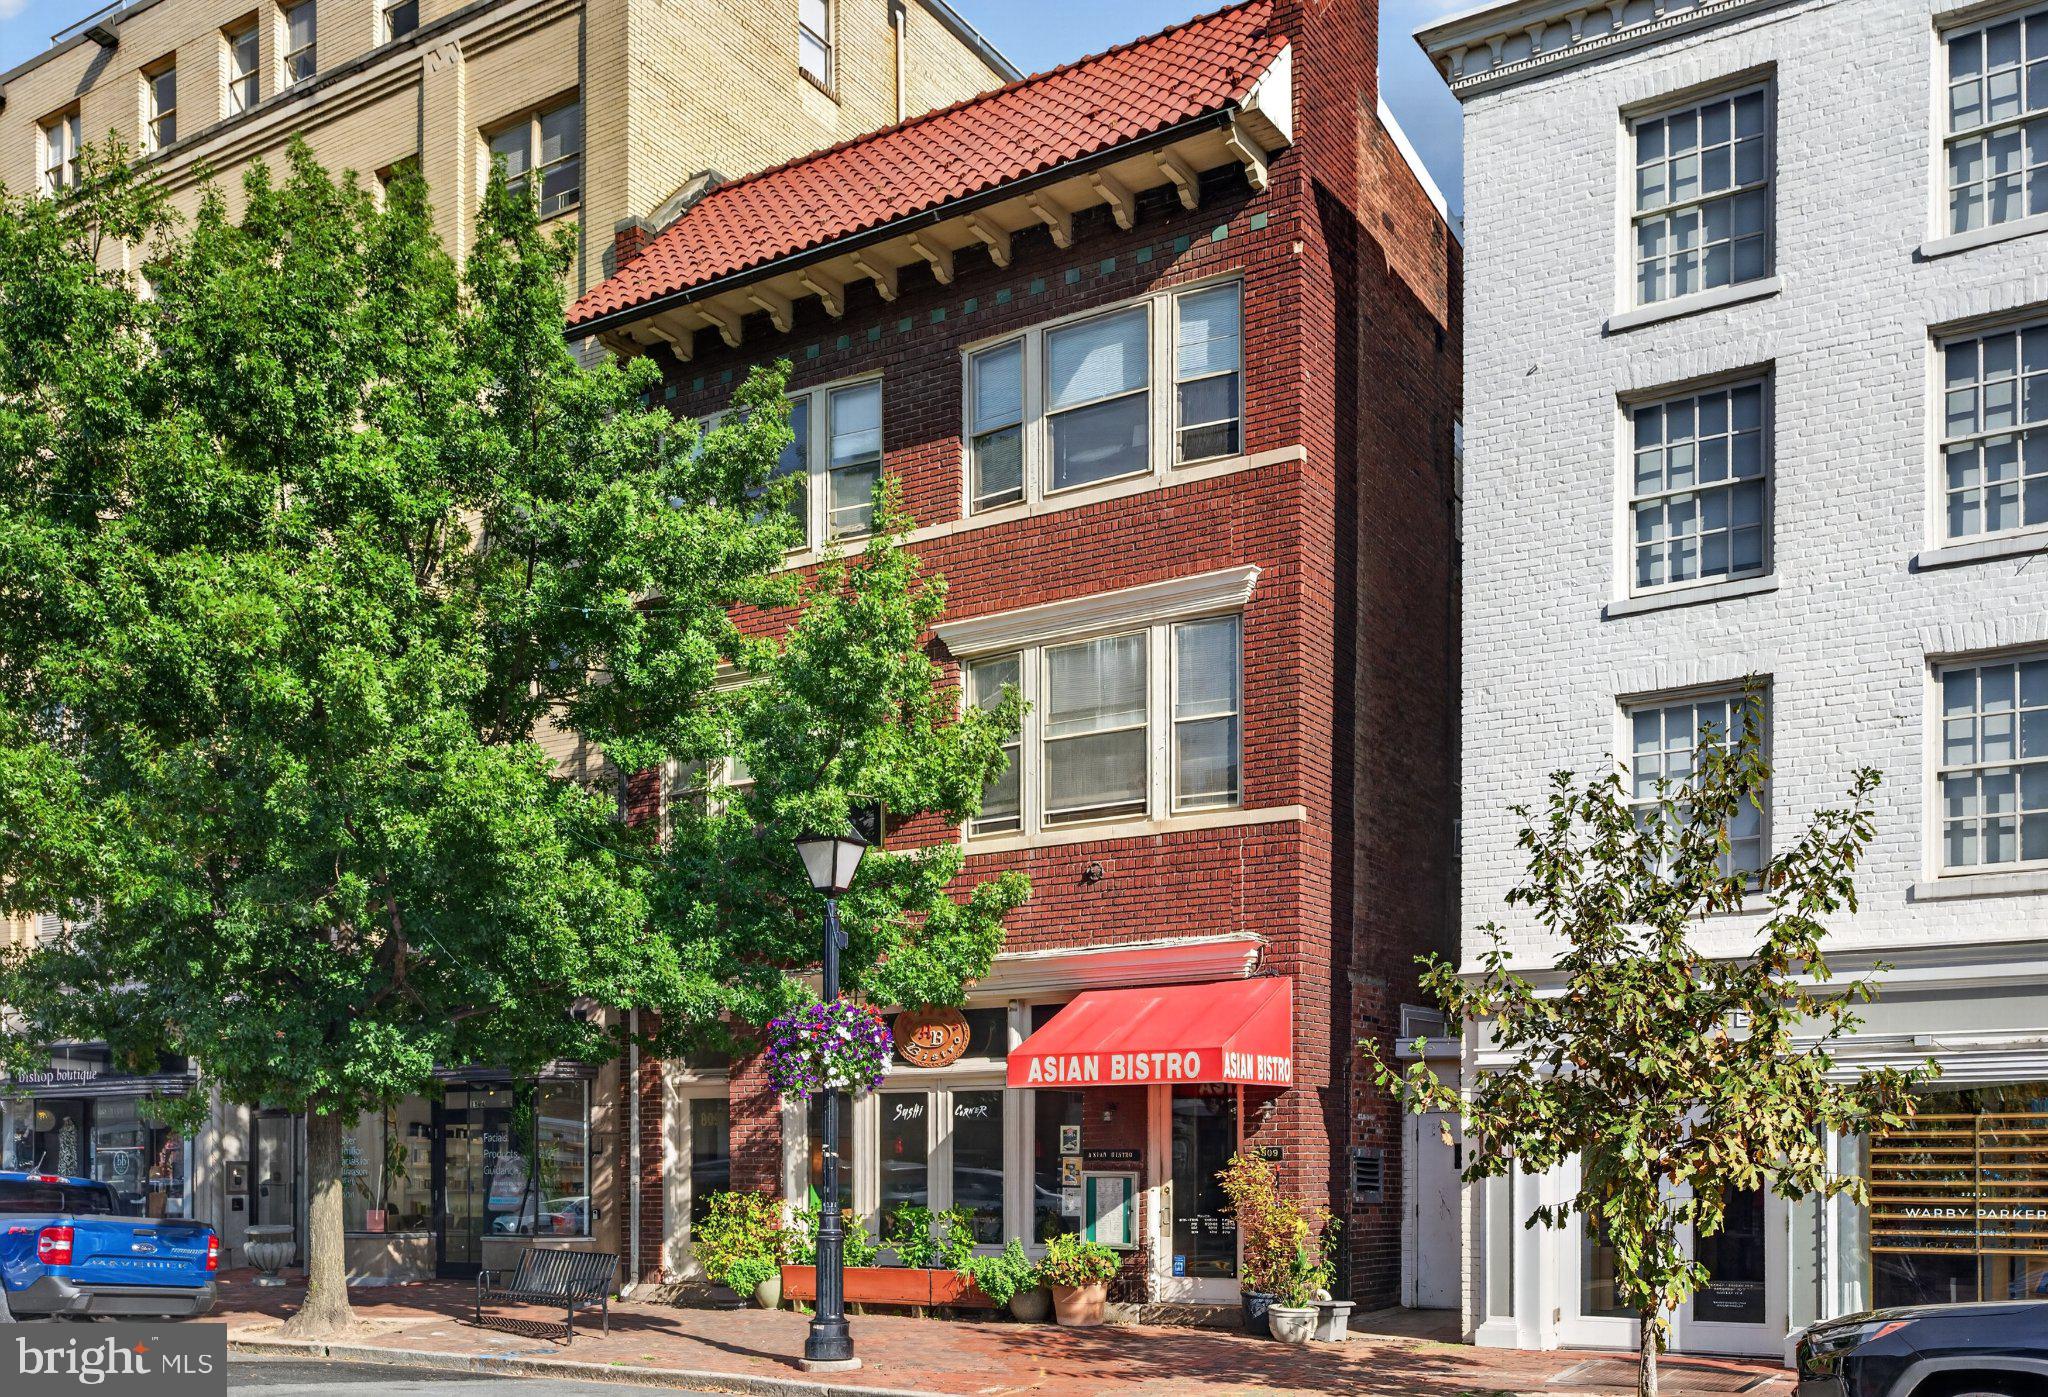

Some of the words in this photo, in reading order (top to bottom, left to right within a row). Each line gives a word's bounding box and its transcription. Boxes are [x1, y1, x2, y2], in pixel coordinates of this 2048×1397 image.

[56, 1067, 97, 1085] boutique
[1028, 1055, 1099, 1082] ASIAN
[1111, 1051, 1200, 1080] BISTRO
[1223, 1051, 1254, 1080] ASIAN
[1257, 1055, 1291, 1082] BISTRO
[1905, 1208, 1969, 1219] WARBY
[1976, 1209, 2047, 1220] PARKER
